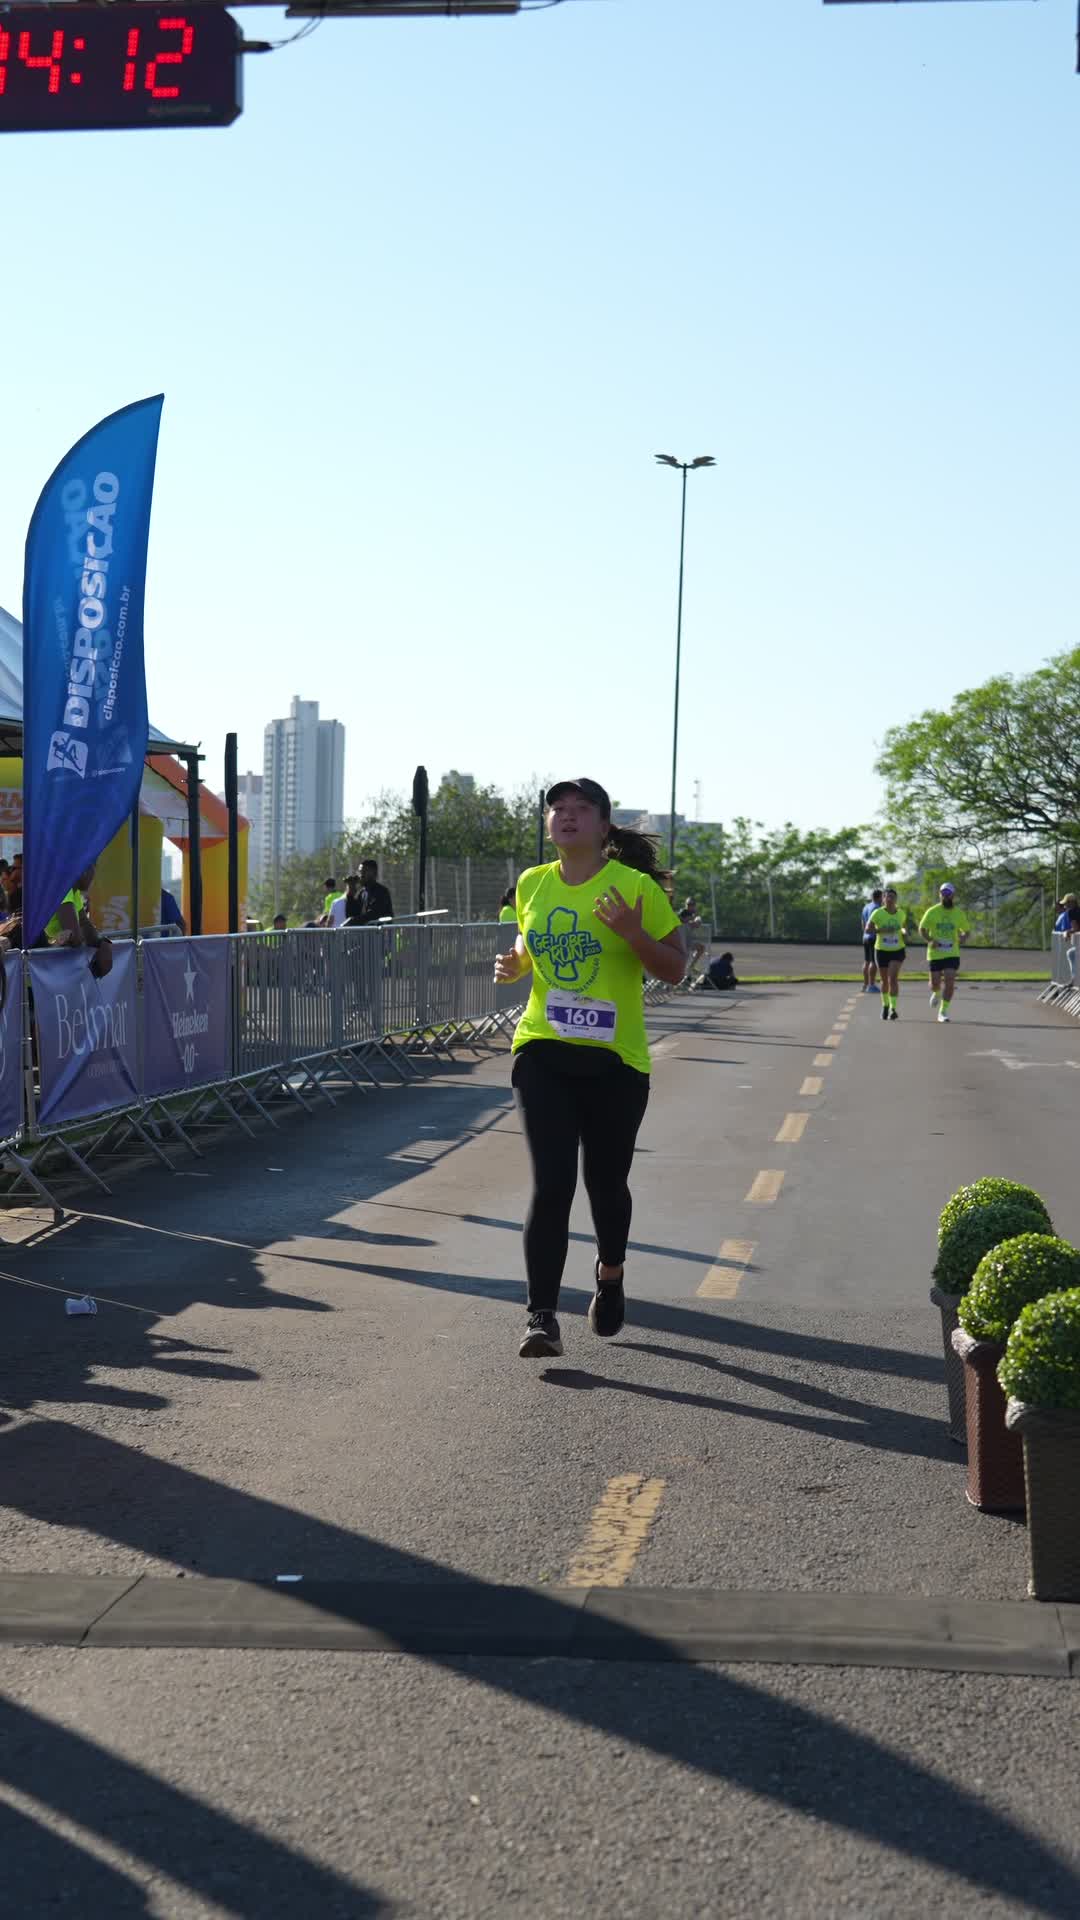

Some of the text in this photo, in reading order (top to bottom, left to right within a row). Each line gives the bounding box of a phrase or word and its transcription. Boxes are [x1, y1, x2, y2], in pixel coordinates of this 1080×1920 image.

[551, 943, 584, 966] RUN
[56, 983, 127, 1059] Belmar
[171, 1009, 209, 1039] Heineken
[565, 1008, 599, 1026] 160
